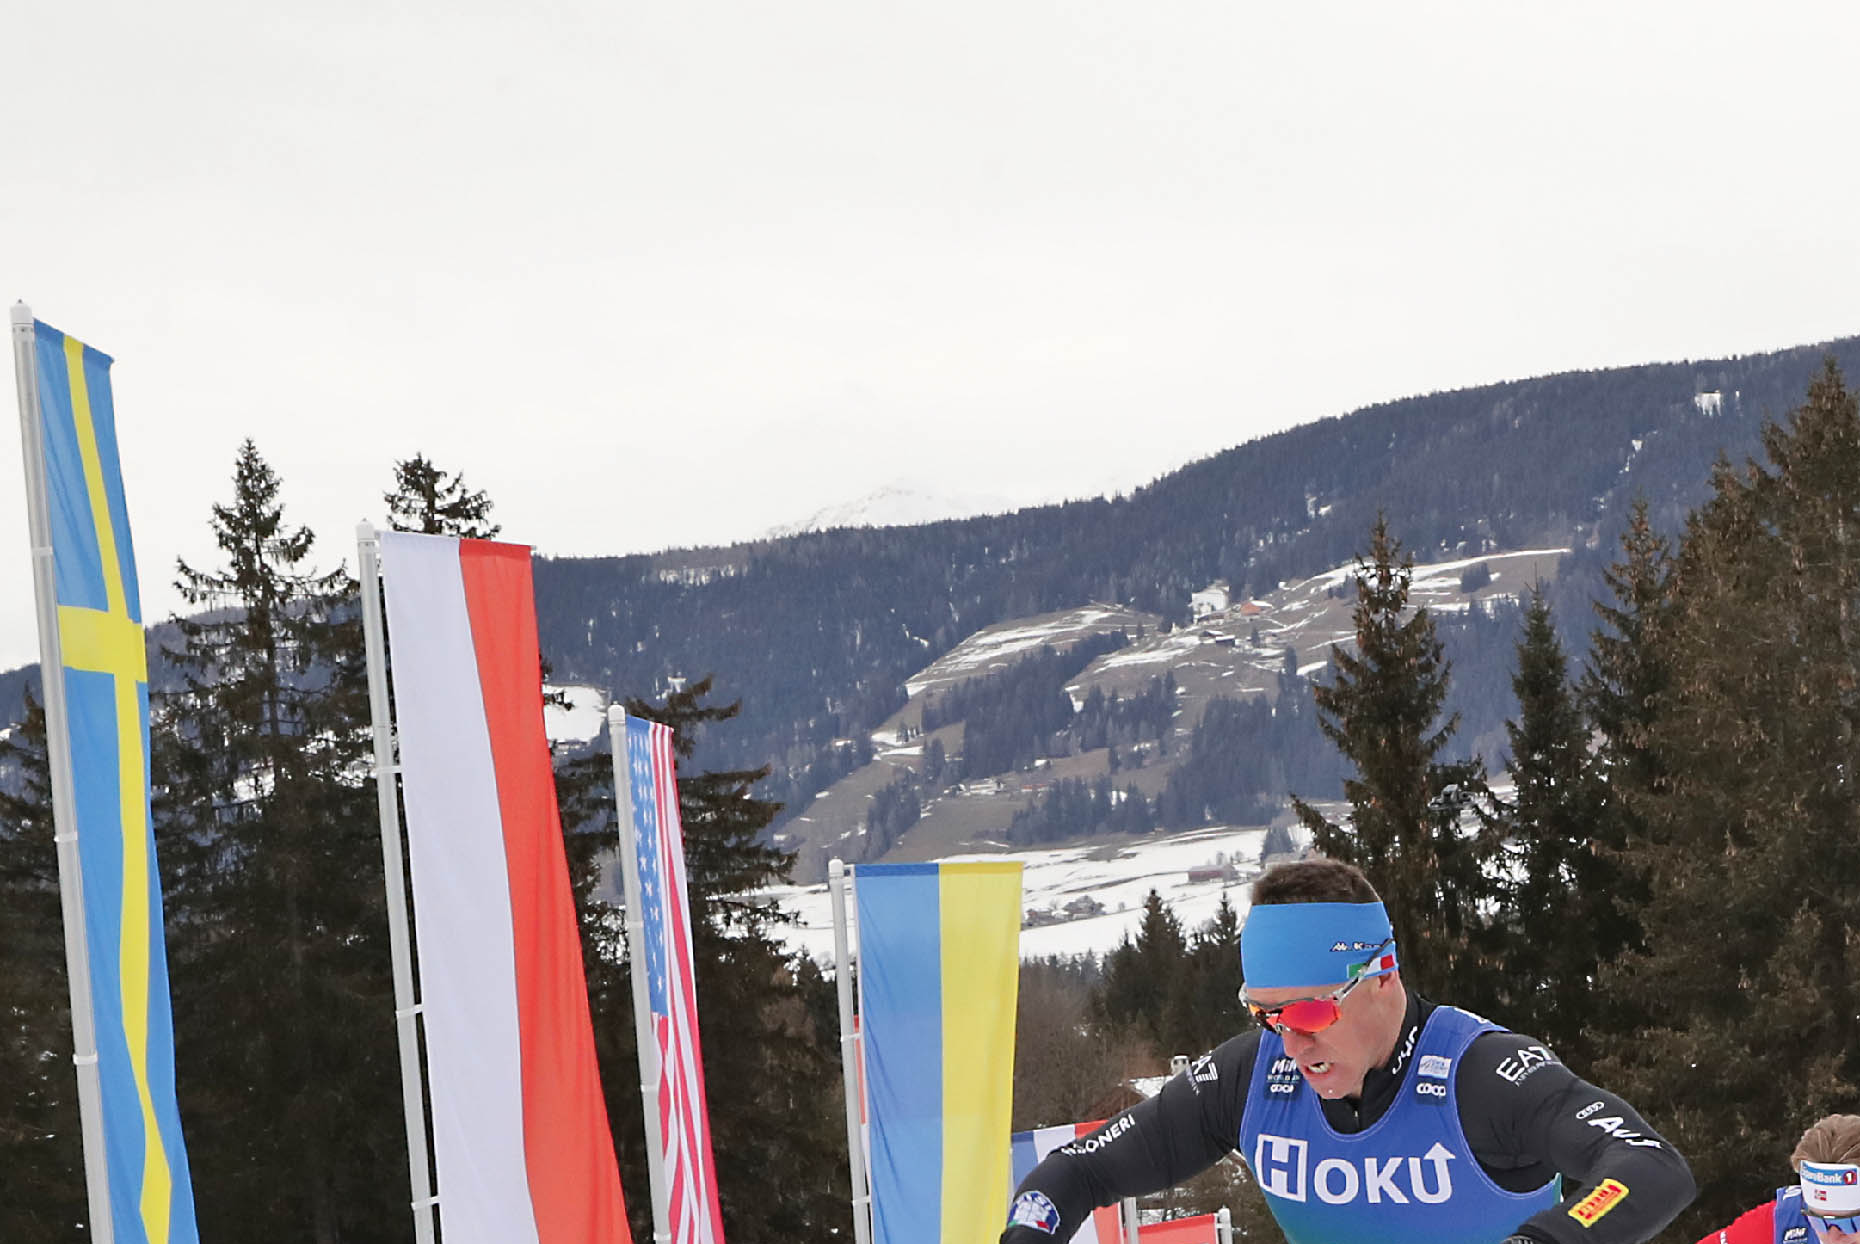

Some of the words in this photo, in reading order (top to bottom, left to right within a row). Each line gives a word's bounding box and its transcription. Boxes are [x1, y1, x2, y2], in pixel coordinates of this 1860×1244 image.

[1496, 1046, 1552, 1082] EA7
[1416, 1082, 1446, 1097] coop
[1254, 1133, 1456, 1205] HOKU
